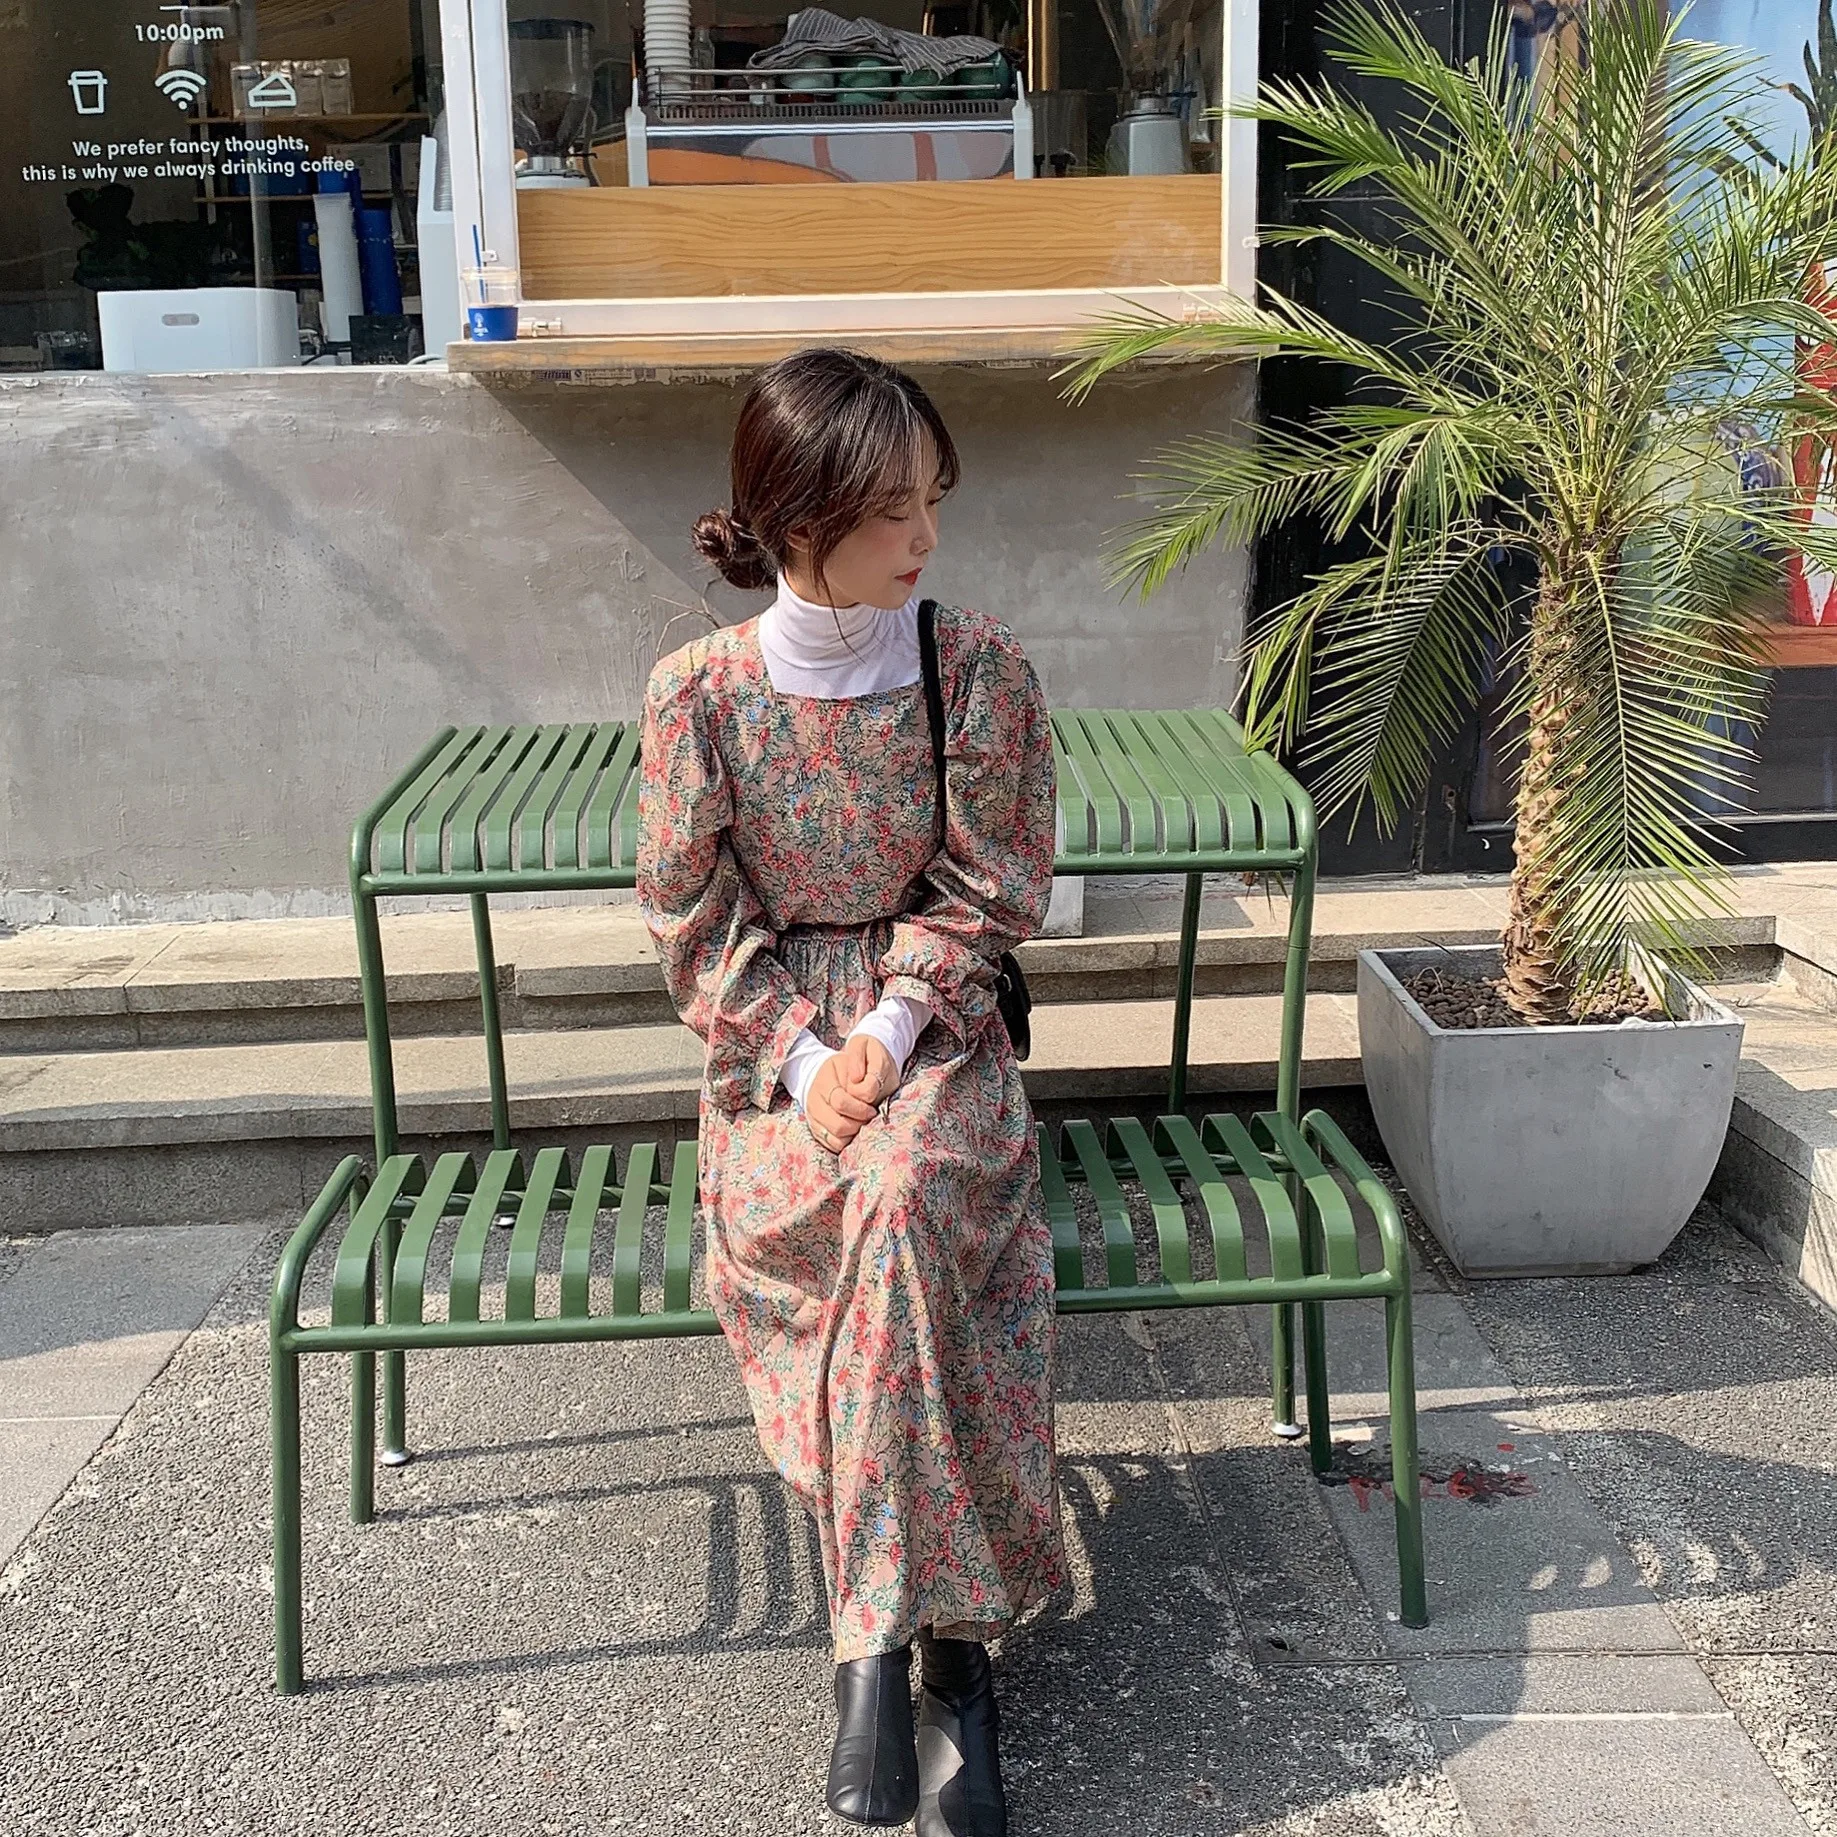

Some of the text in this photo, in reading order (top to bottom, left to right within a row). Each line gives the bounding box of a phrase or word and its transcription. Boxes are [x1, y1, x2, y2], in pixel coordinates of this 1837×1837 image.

[135, 23, 224, 45] 10:00pm
[72, 134, 309, 160] We prefer fancy thoughts,
[22, 156, 355, 183] this is why we always drinking coffee
